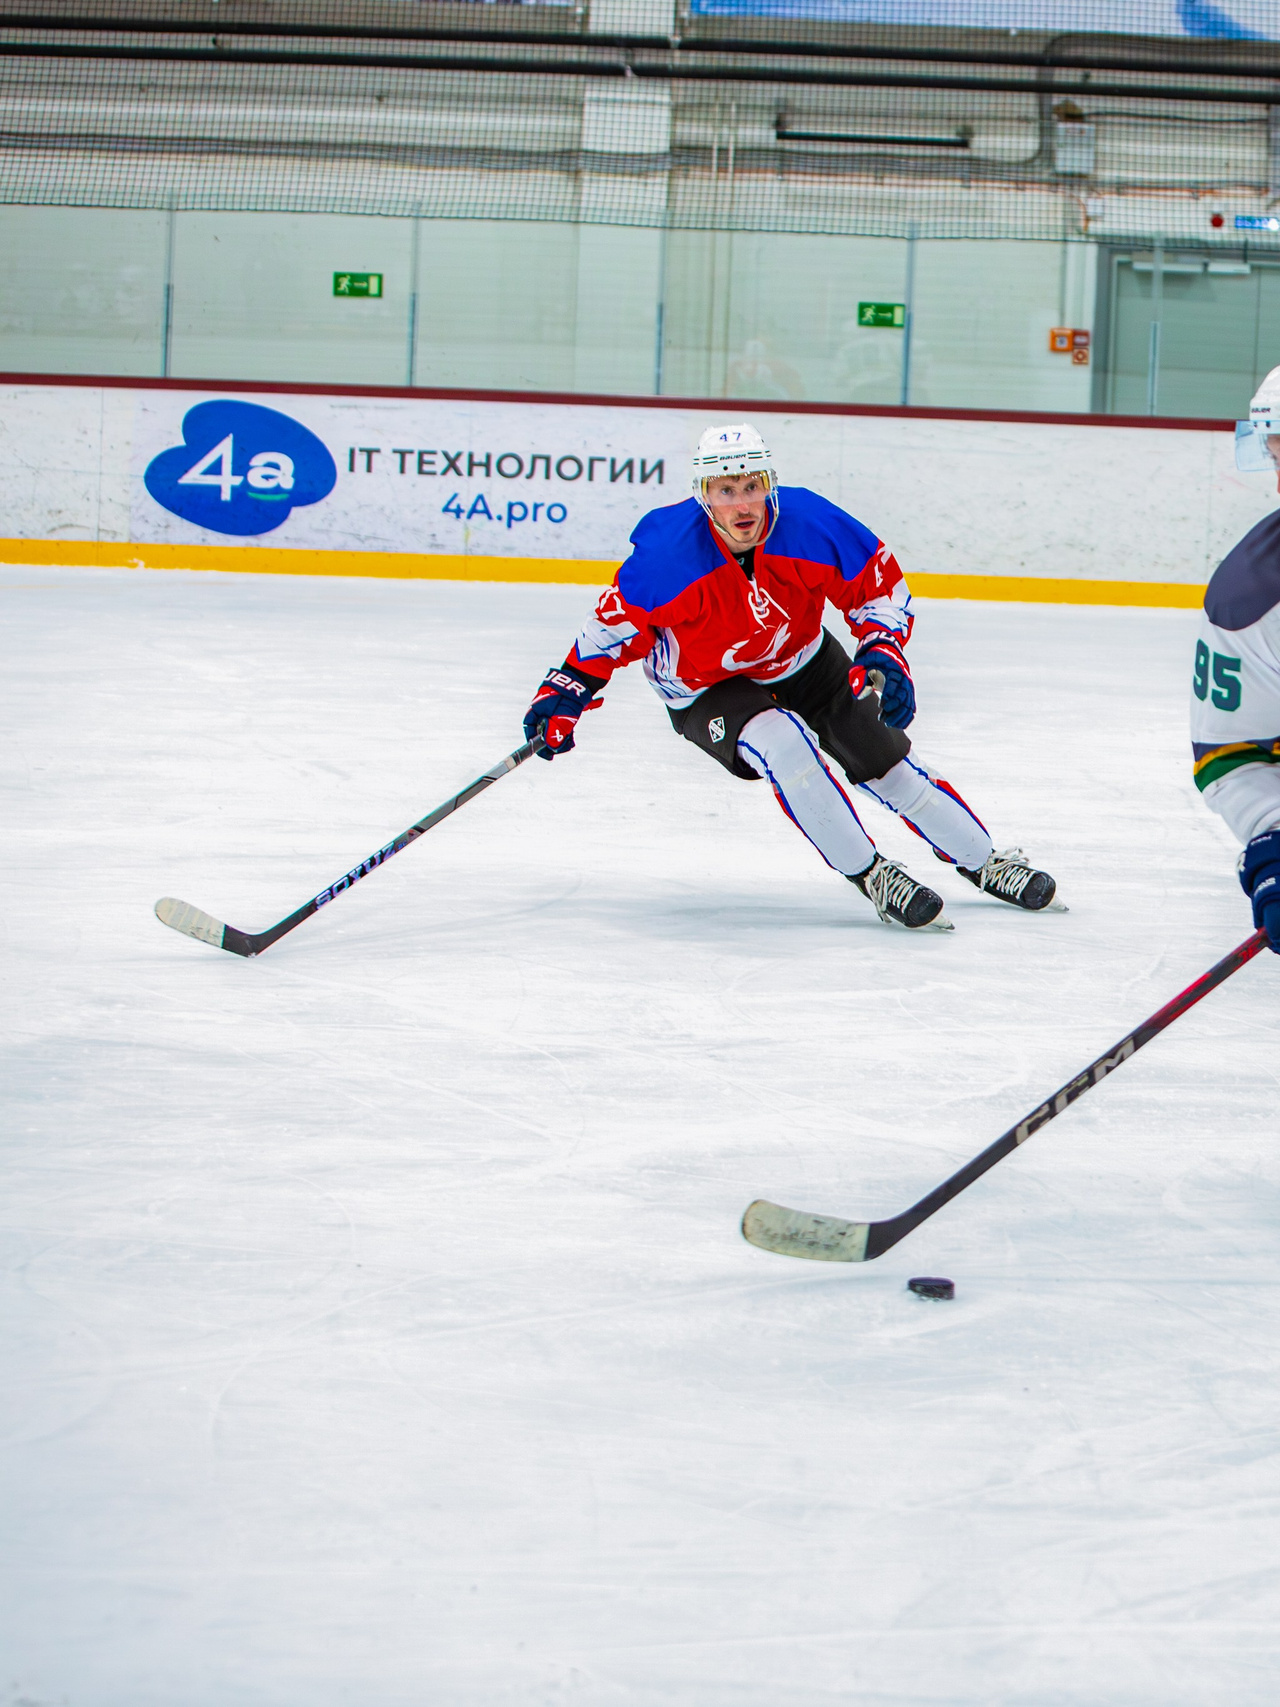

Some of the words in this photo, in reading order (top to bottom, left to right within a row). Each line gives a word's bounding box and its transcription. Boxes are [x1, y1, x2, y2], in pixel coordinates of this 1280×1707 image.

[177, 432, 295, 502] 4a
[348, 447, 381, 473] IT
[392, 449, 665, 484] ТЕХНОЛОГИИ
[720, 432, 742, 442] 47
[441, 493, 568, 529] 4A.pro
[1193, 638, 1242, 712] 95
[316, 841, 396, 910] SOYUZ
[1016, 1035, 1135, 1145] CCM
